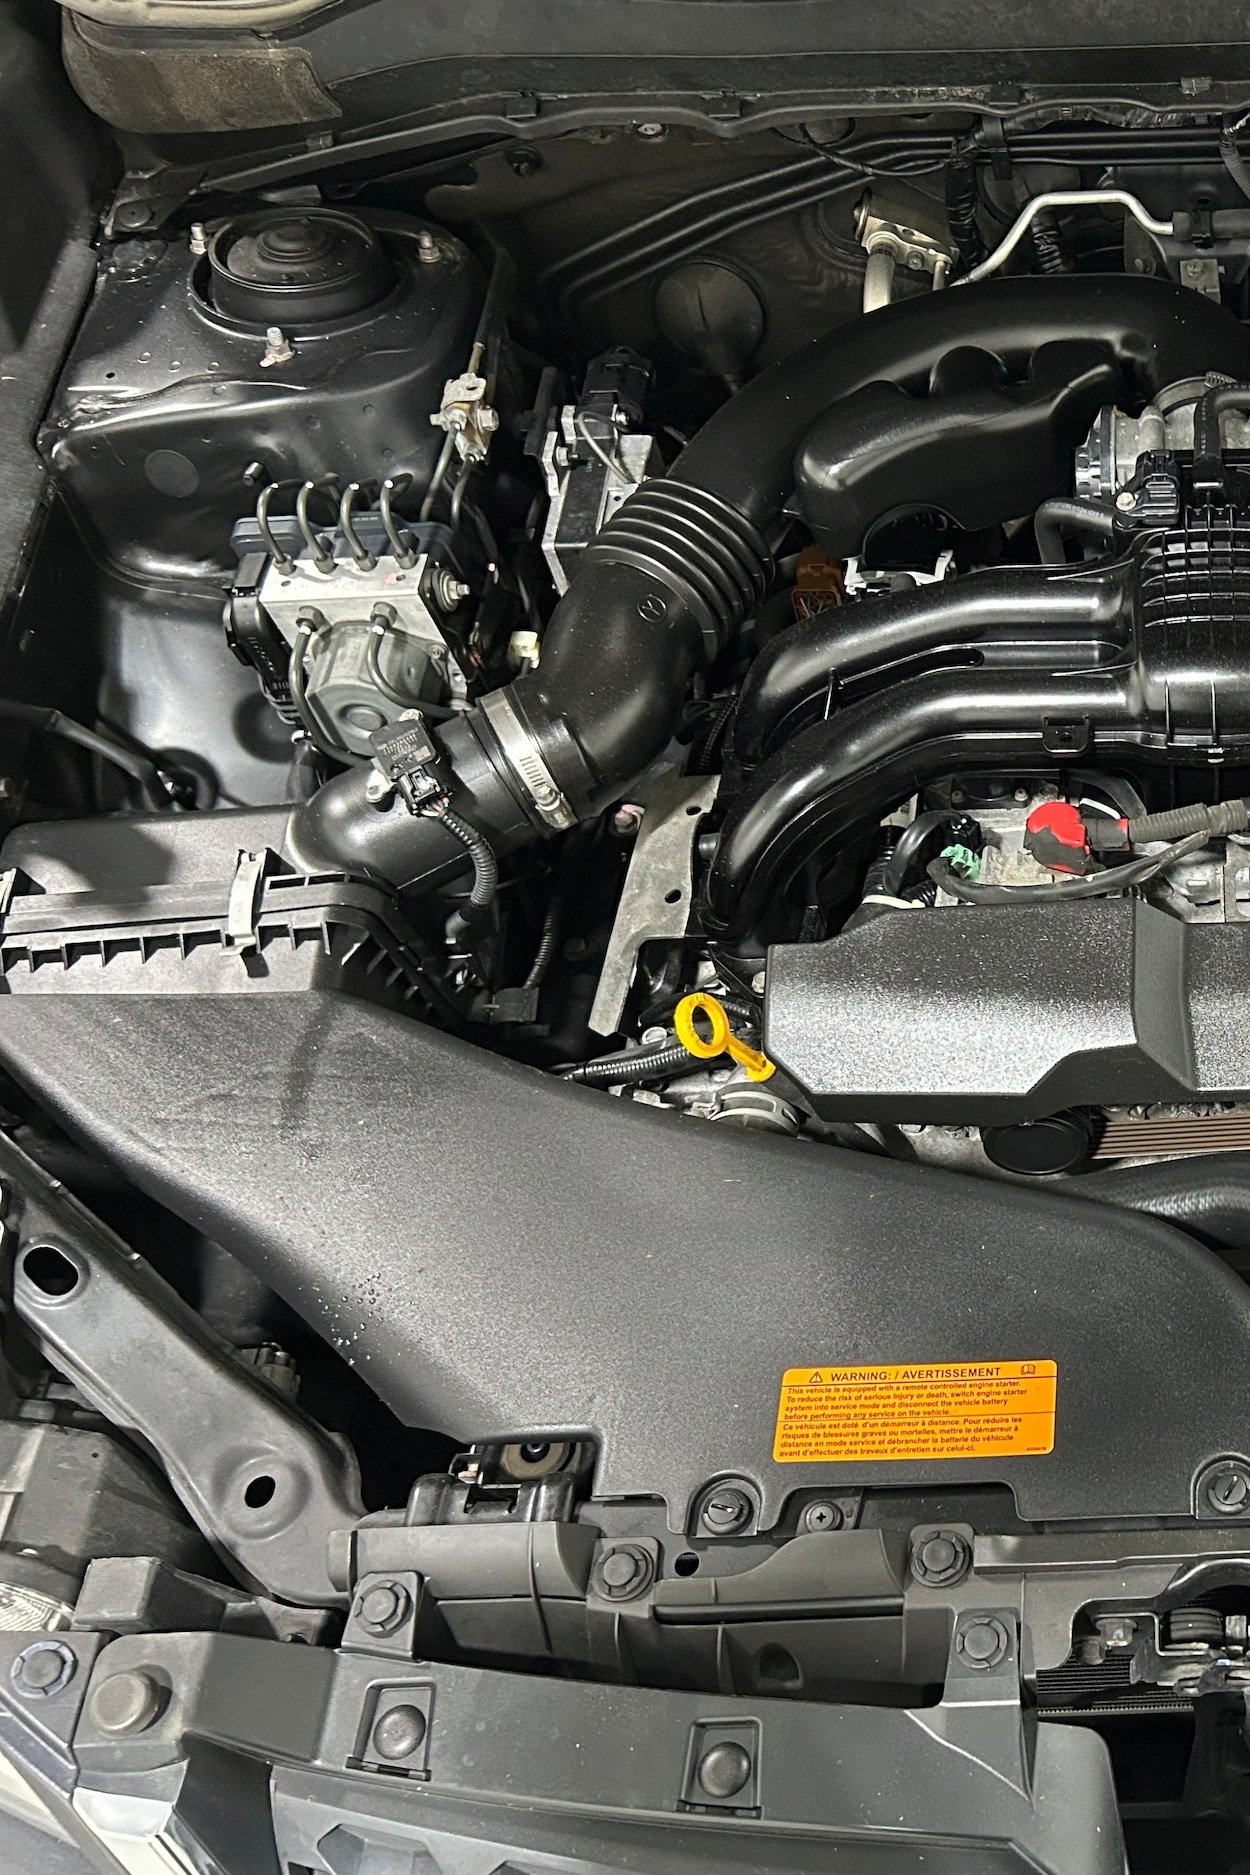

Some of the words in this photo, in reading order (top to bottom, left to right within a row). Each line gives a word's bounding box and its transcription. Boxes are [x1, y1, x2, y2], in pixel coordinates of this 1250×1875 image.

[831, 1371, 891, 1381] WARNING:
[894, 1371, 899, 1379] /
[902, 1367, 1001, 1380] AVERTISSEMENT
[842, 1385, 876, 1394] equipped
[854, 1393, 862, 1401] of
[785, 1405, 812, 1413] system
[982, 1398, 1008, 1406] battery
[810, 1413, 851, 1421] performing
